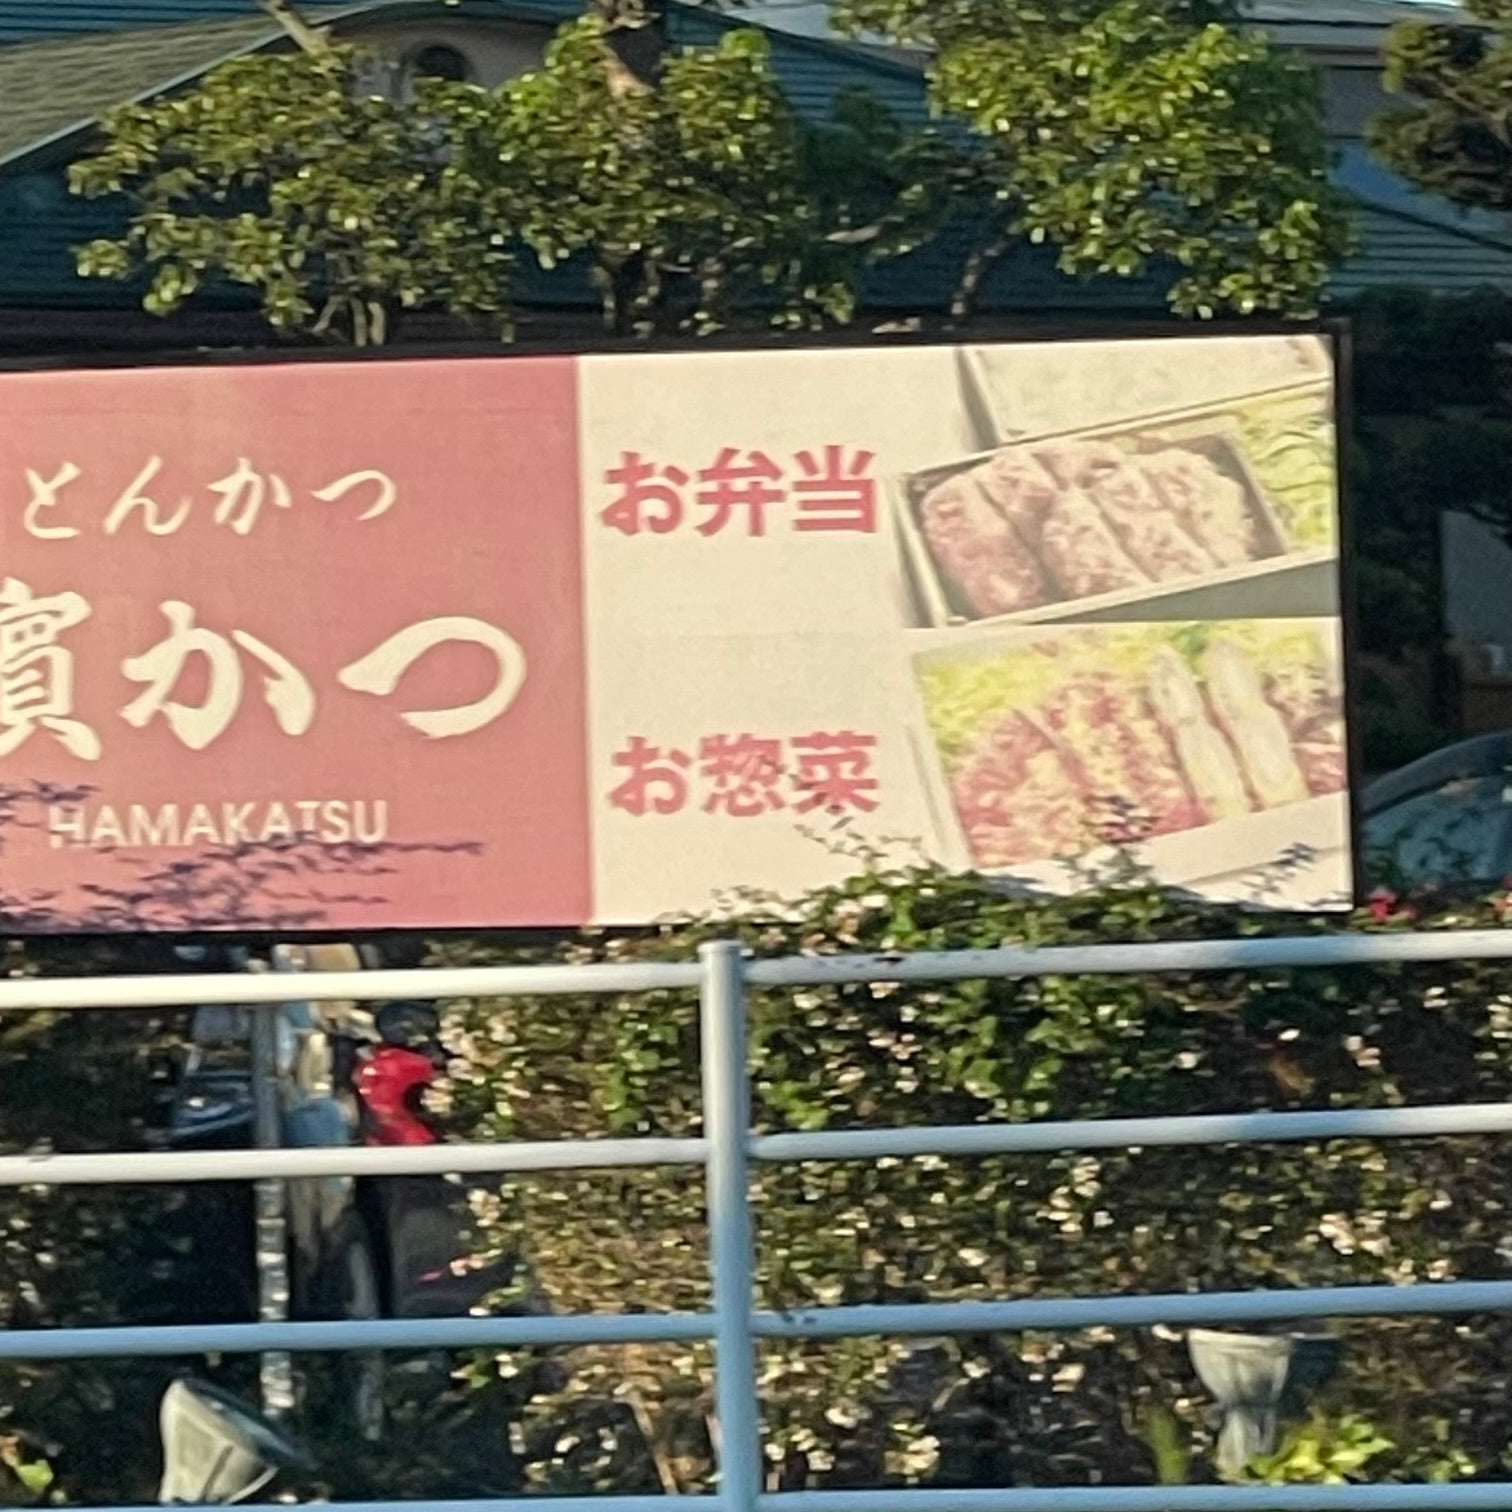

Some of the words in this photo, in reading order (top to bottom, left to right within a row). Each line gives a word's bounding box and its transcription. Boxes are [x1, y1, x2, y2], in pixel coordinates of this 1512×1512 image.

[22, 456, 397, 539] とんかつ
[601, 444, 878, 537] お弁当
[608, 730, 879, 817] お惣菜
[49, 800, 388, 849] HAMAKATSU
